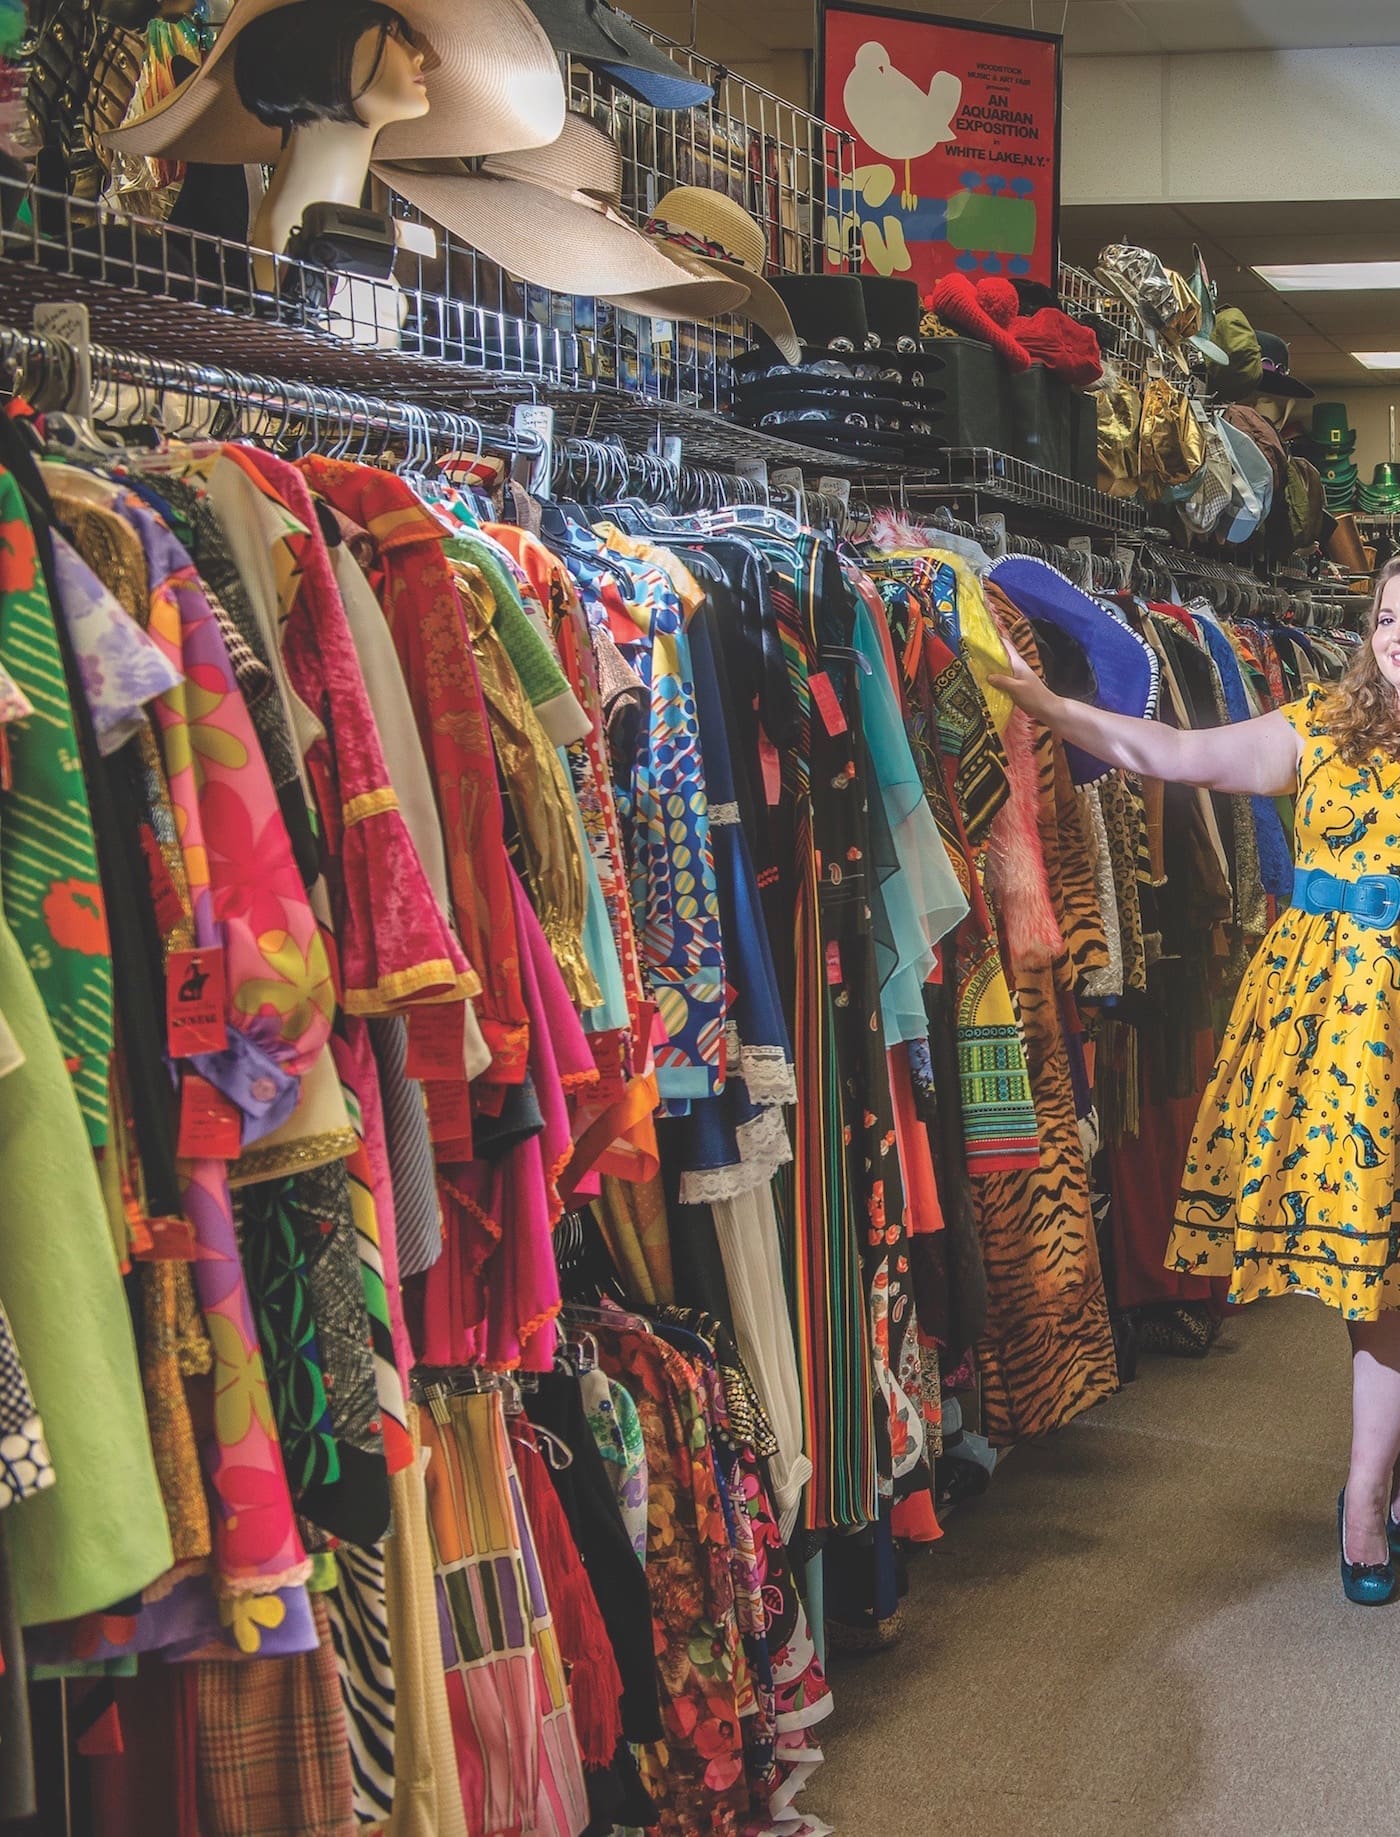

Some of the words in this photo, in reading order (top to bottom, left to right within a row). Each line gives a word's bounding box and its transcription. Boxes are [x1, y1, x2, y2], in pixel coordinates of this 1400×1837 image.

[976, 63, 1022, 74] WOODSTOCK
[988, 95, 1008, 107] AN
[961, 105, 1033, 125] AQUARIAN
[956, 118, 1039, 140] EXPOSITION
[945, 144, 986, 160] WHITE
